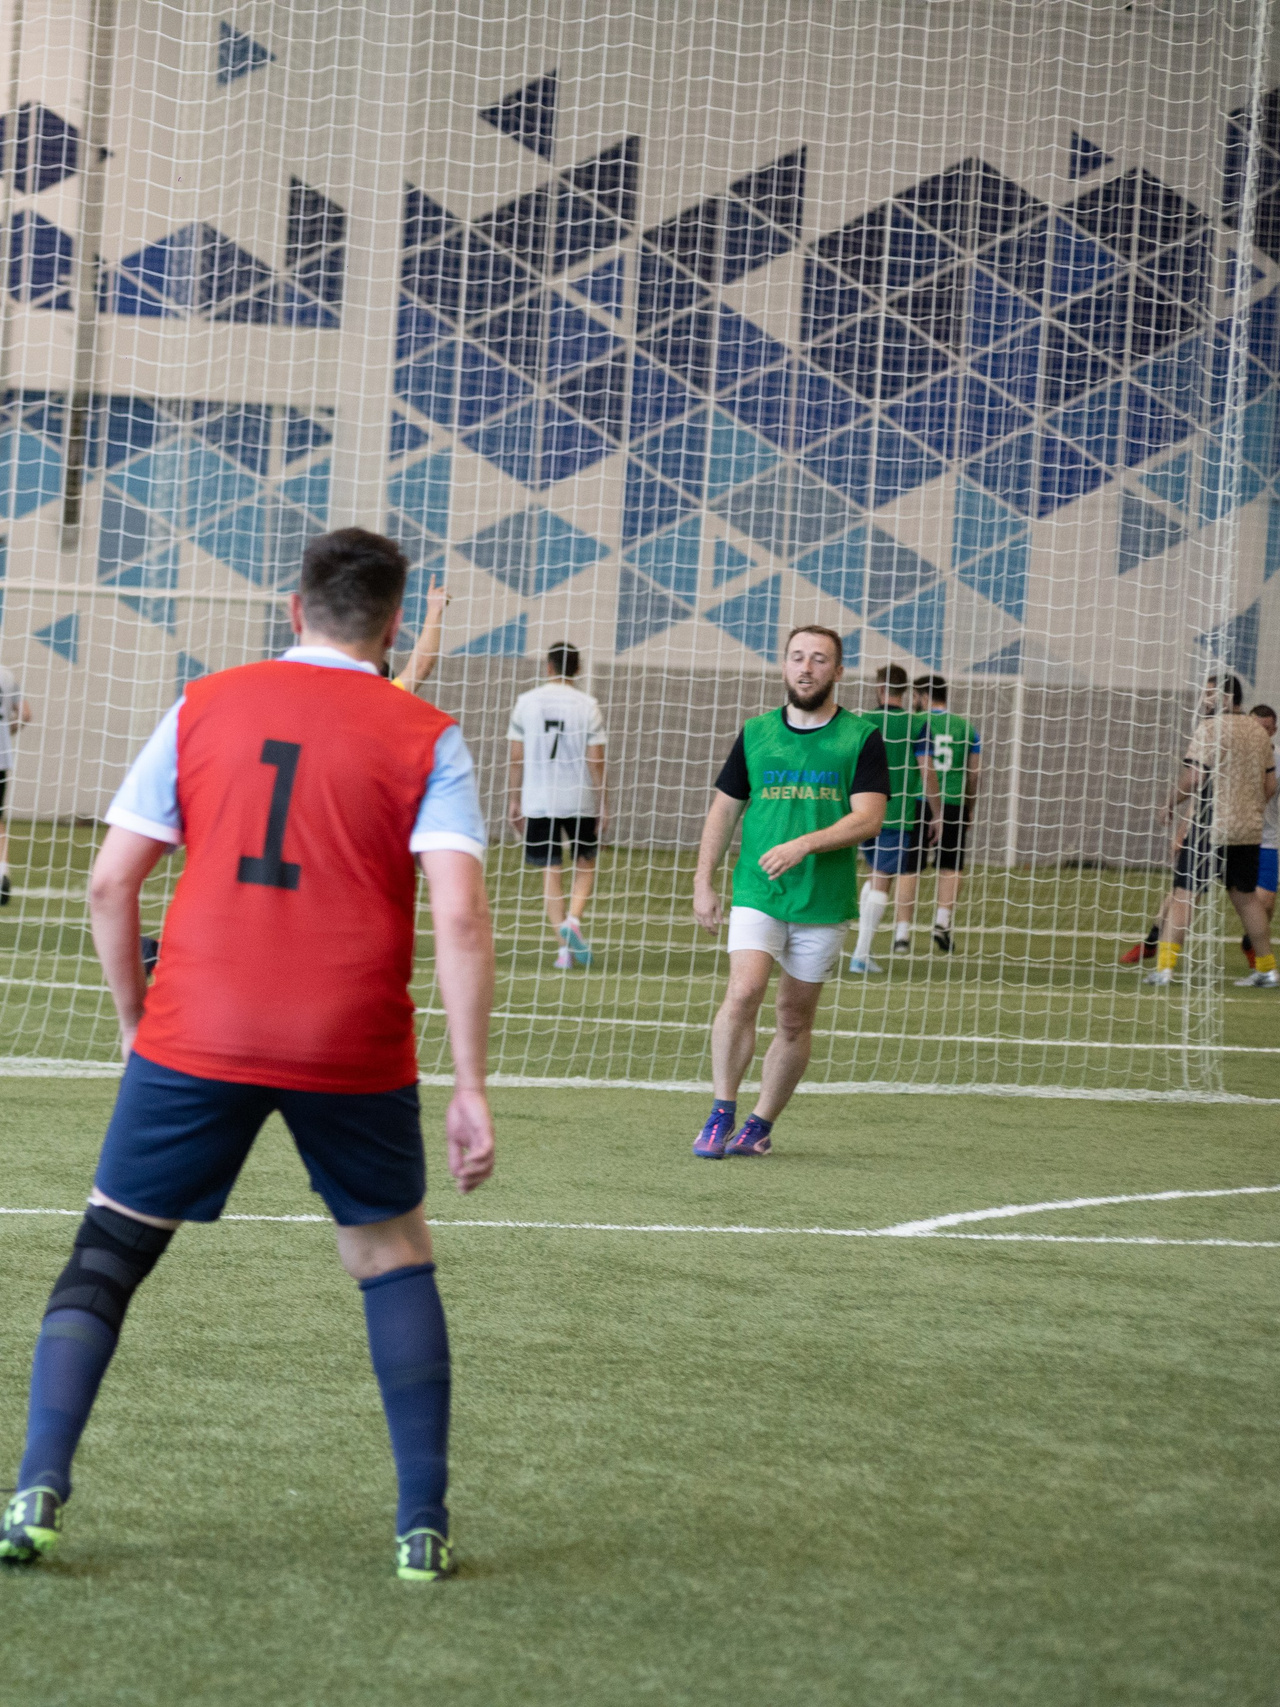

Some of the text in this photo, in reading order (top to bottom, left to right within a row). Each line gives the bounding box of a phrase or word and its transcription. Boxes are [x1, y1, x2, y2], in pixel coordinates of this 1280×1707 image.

[544, 719, 565, 760] 7
[933, 734, 953, 771] 5
[761, 786, 842, 802] ARENA.RU
[763, 770, 839, 785] DYNAMO
[237, 739, 303, 891] 1
